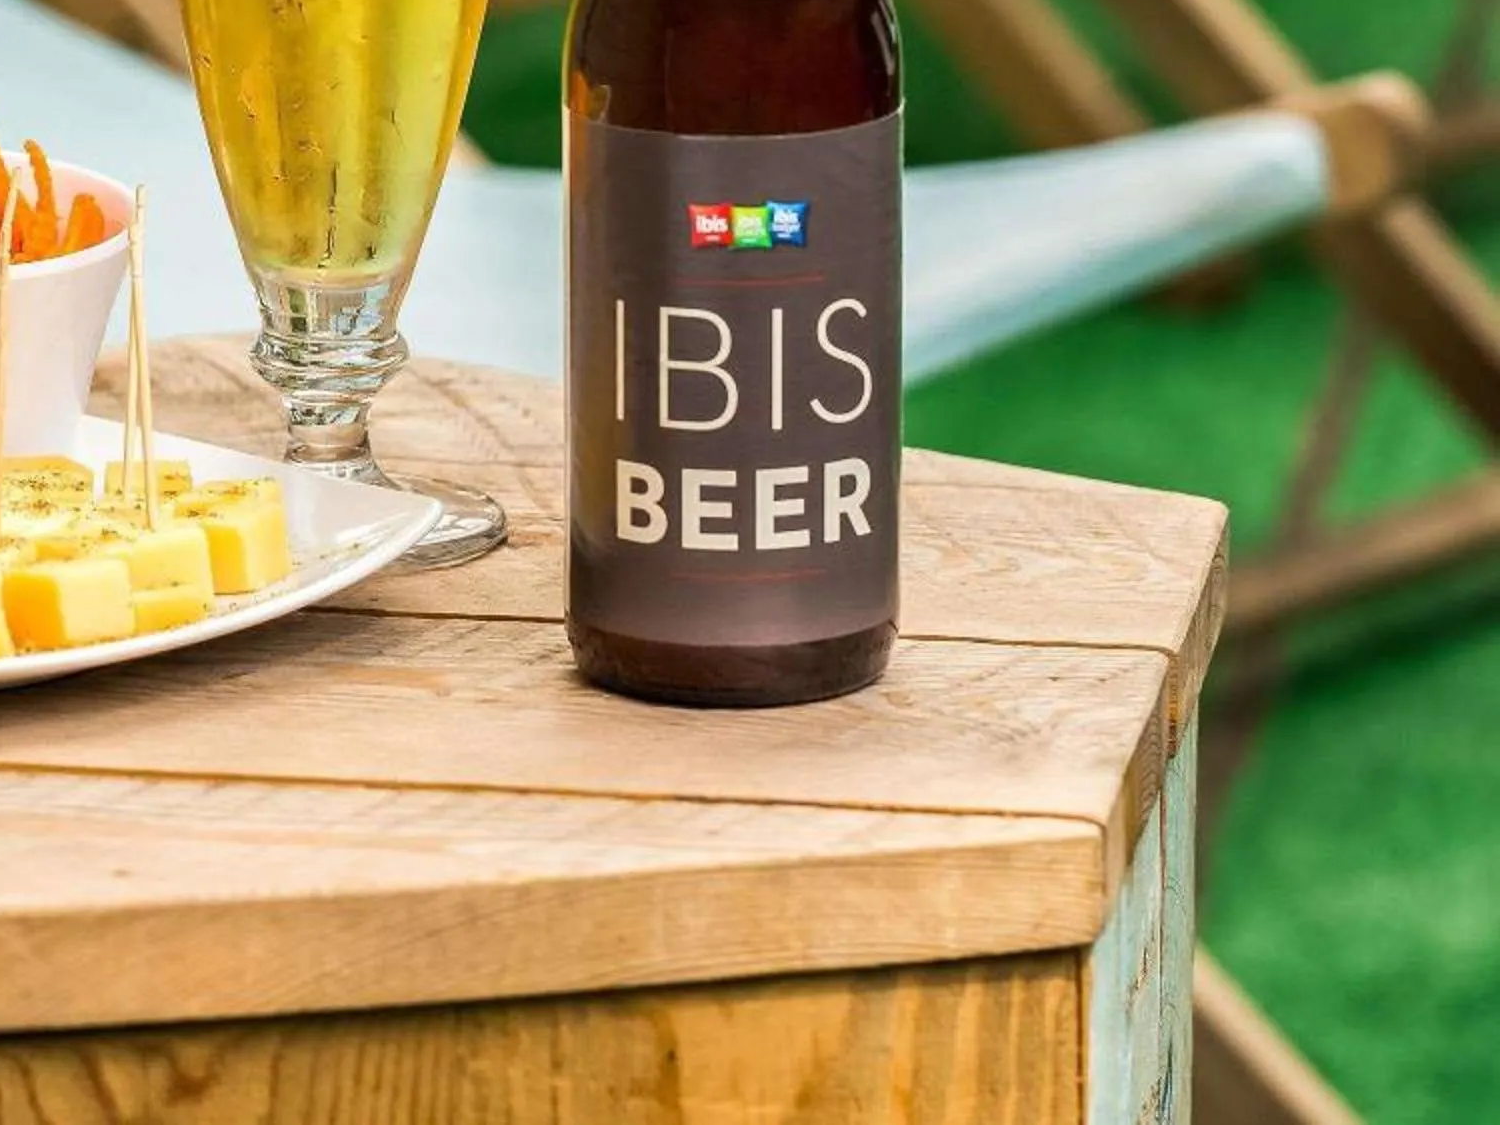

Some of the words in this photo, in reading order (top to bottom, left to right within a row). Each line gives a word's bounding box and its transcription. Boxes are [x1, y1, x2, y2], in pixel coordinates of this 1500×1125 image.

[695, 214, 728, 233] ibis
[615, 297, 873, 431] IBIS
[615, 457, 873, 552] BEER
